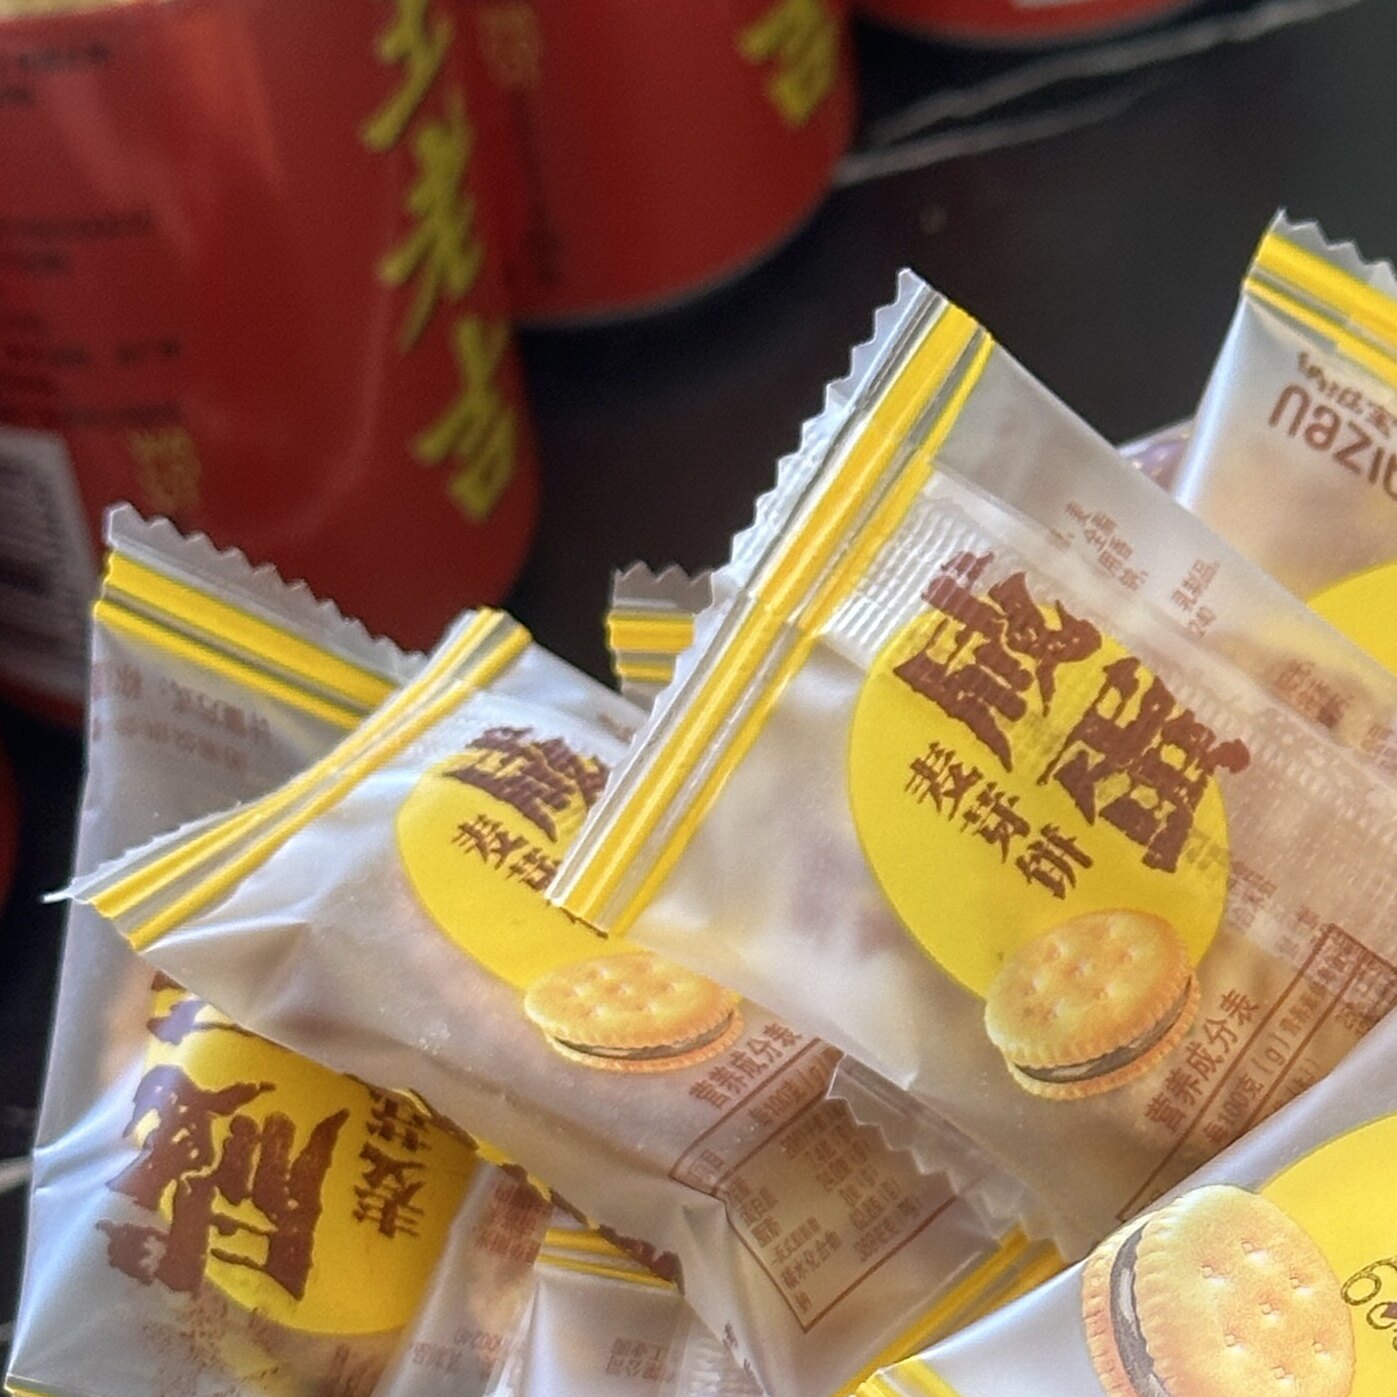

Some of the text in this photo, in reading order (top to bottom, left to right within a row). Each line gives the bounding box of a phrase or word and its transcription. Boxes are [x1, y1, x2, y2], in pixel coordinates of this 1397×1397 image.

[903, 741, 1095, 901] 麦芽饼
[1144, 983, 1261, 1135] 营养成分表
